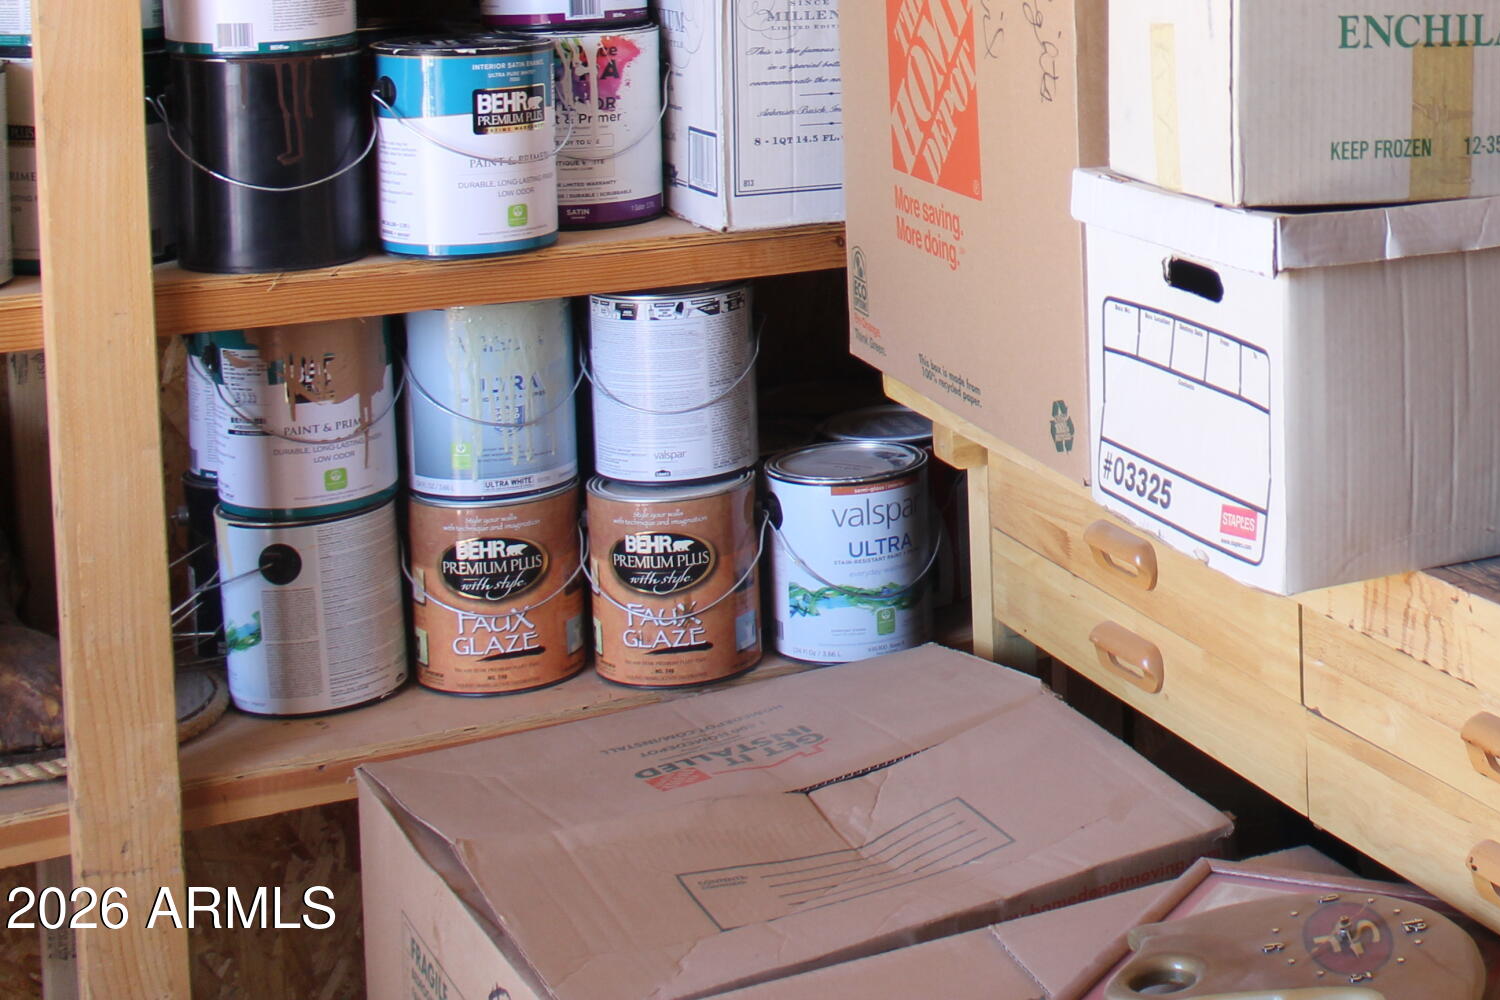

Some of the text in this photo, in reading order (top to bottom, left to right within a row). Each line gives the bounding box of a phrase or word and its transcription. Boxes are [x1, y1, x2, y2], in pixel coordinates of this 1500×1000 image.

[477, 91, 527, 114] BEHR
[922, 38, 977, 185] DEPOT
[478, 110, 544, 126] PREMIUM PLUS
[1330, 141, 1368, 160] KEEP
[1374, 138, 1432, 159] FROZEN
[470, 157, 505, 169] PAINT
[894, 184, 964, 241] More saving.
[896, 215, 961, 272] More doing.
[284, 425, 318, 436] PAINT
[323, 423, 332, 432] &
[314, 451, 355, 463] LOW ODOR
[512, 477, 532, 486] WHITE
[1103, 451, 1172, 509] #03325
[1222, 512, 1255, 531] STAPLES
[456, 540, 505, 560] BEHR
[625, 534, 672, 553] BEHR
[849, 533, 912, 557] ULTRA
[443, 555, 542, 575] PREMIUM PLUS
[613, 551, 709, 569] PREMIUM PLUS
[461, 570, 527, 600] with style
[630, 566, 691, 595] with style
[457, 607, 535, 635] FAUX
[627, 601, 702, 627] FAUX
[453, 632, 540, 656] GLAZE
[623, 627, 707, 649] GLAZE
[634, 724, 813, 779] INSTALLED
[726, 732, 825, 767] GET IT
